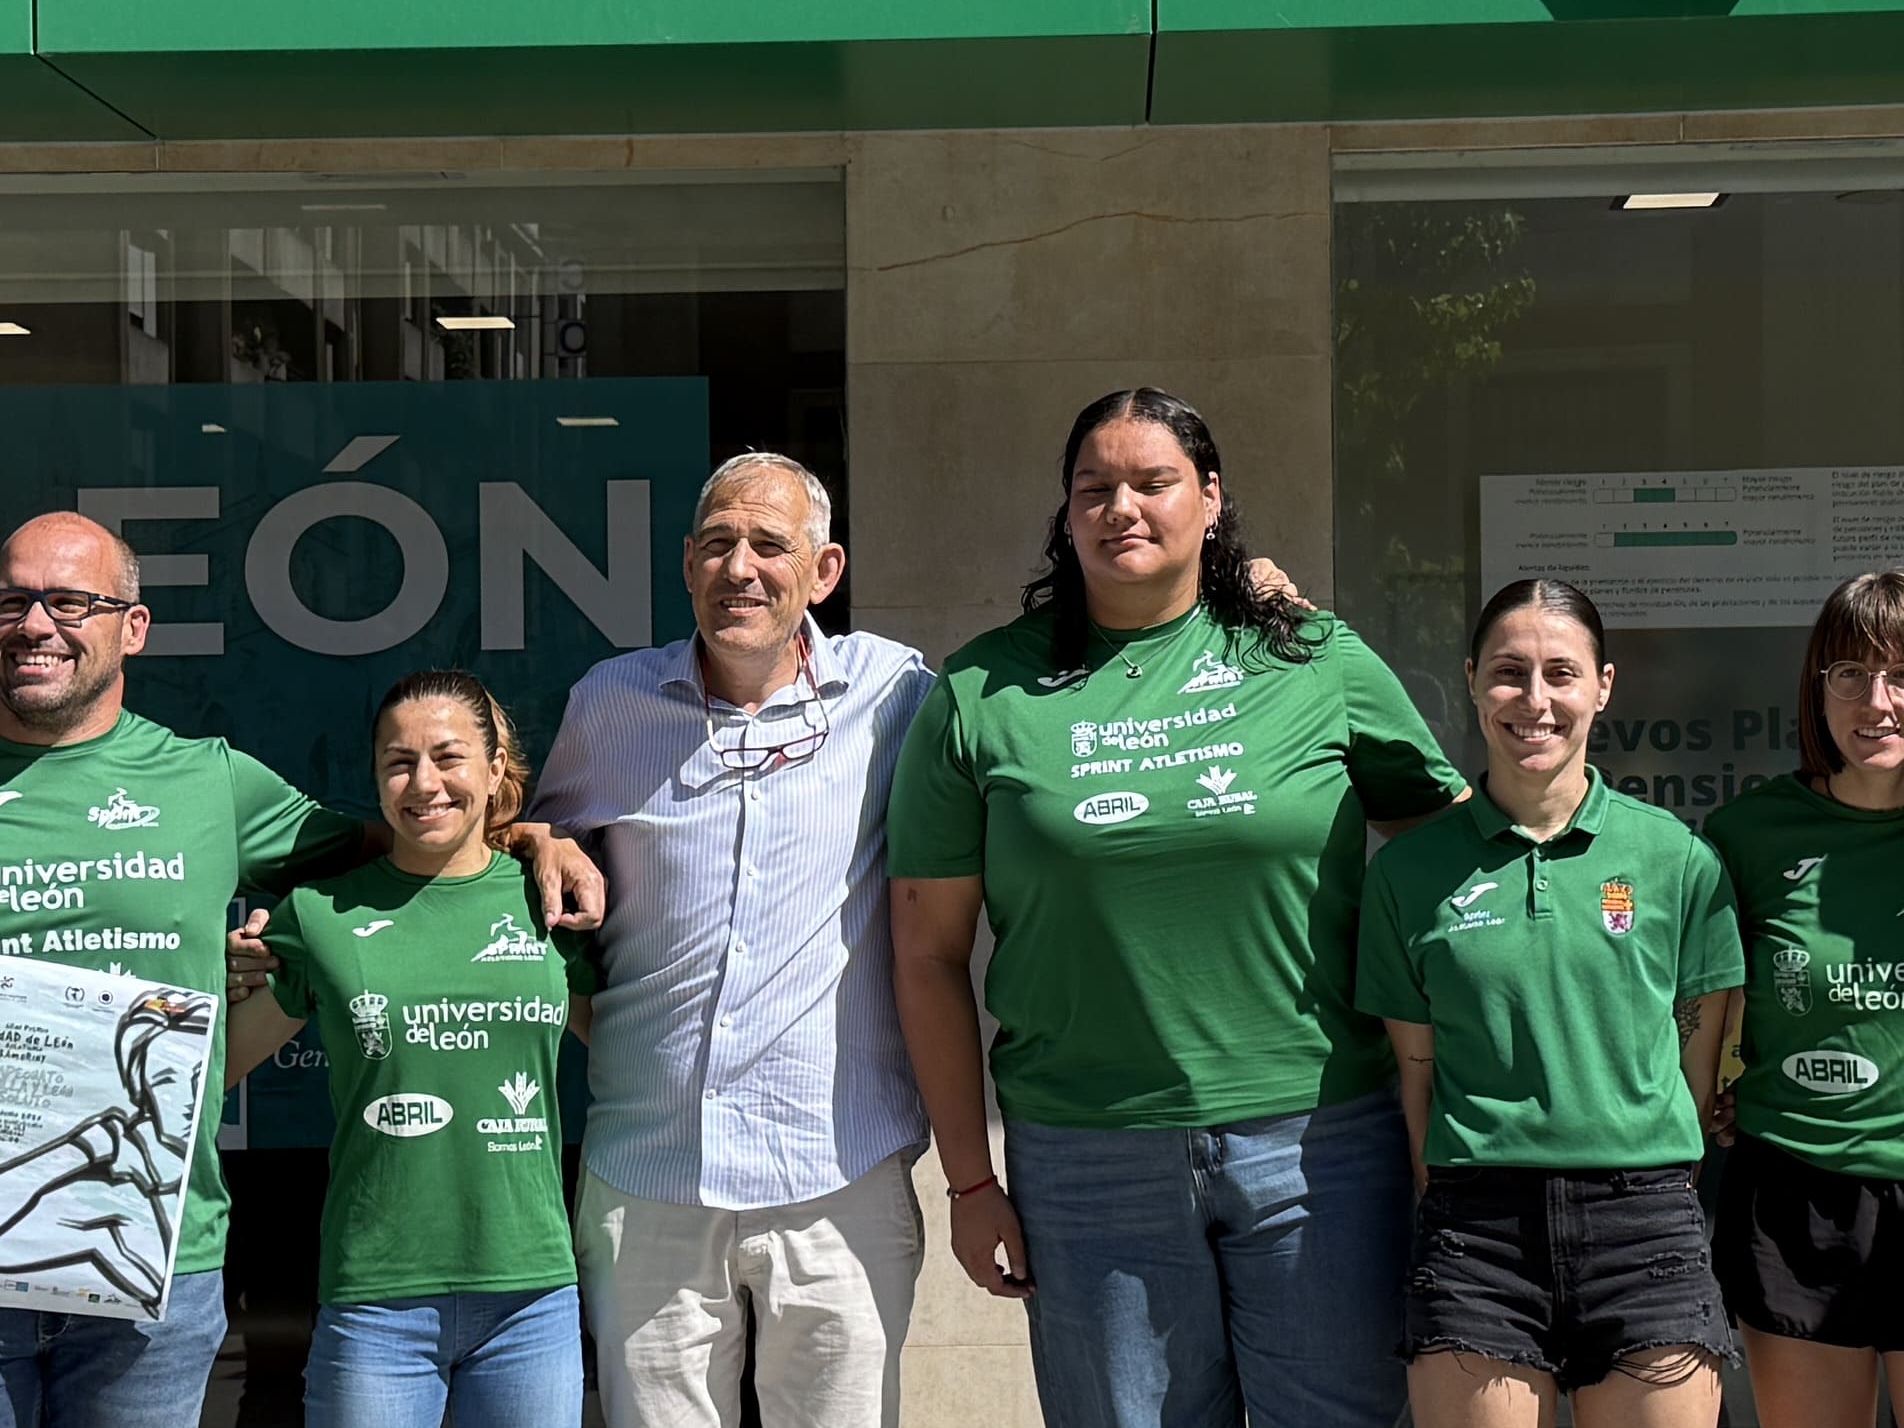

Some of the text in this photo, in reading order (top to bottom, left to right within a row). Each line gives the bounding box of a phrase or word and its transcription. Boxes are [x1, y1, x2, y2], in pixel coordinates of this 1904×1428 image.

[1099, 703, 1238, 736] universidad
[1589, 706, 1800, 754] evos Pla
[1118, 730, 1169, 751] león
[1071, 742, 1245, 778] SPRINT ATLETISMO
[1083, 795, 1141, 820] ABRIL
[9, 882, 84, 913] león
[42, 926, 181, 954] Atletismo
[1828, 984, 1854, 1003] de
[403, 995, 565, 1026] universidad
[405, 1022, 489, 1051] de león
[273, 1039, 330, 1070] Gen
[1795, 1057, 1868, 1084] ABRIL
[377, 1101, 443, 1126] ABRIL
